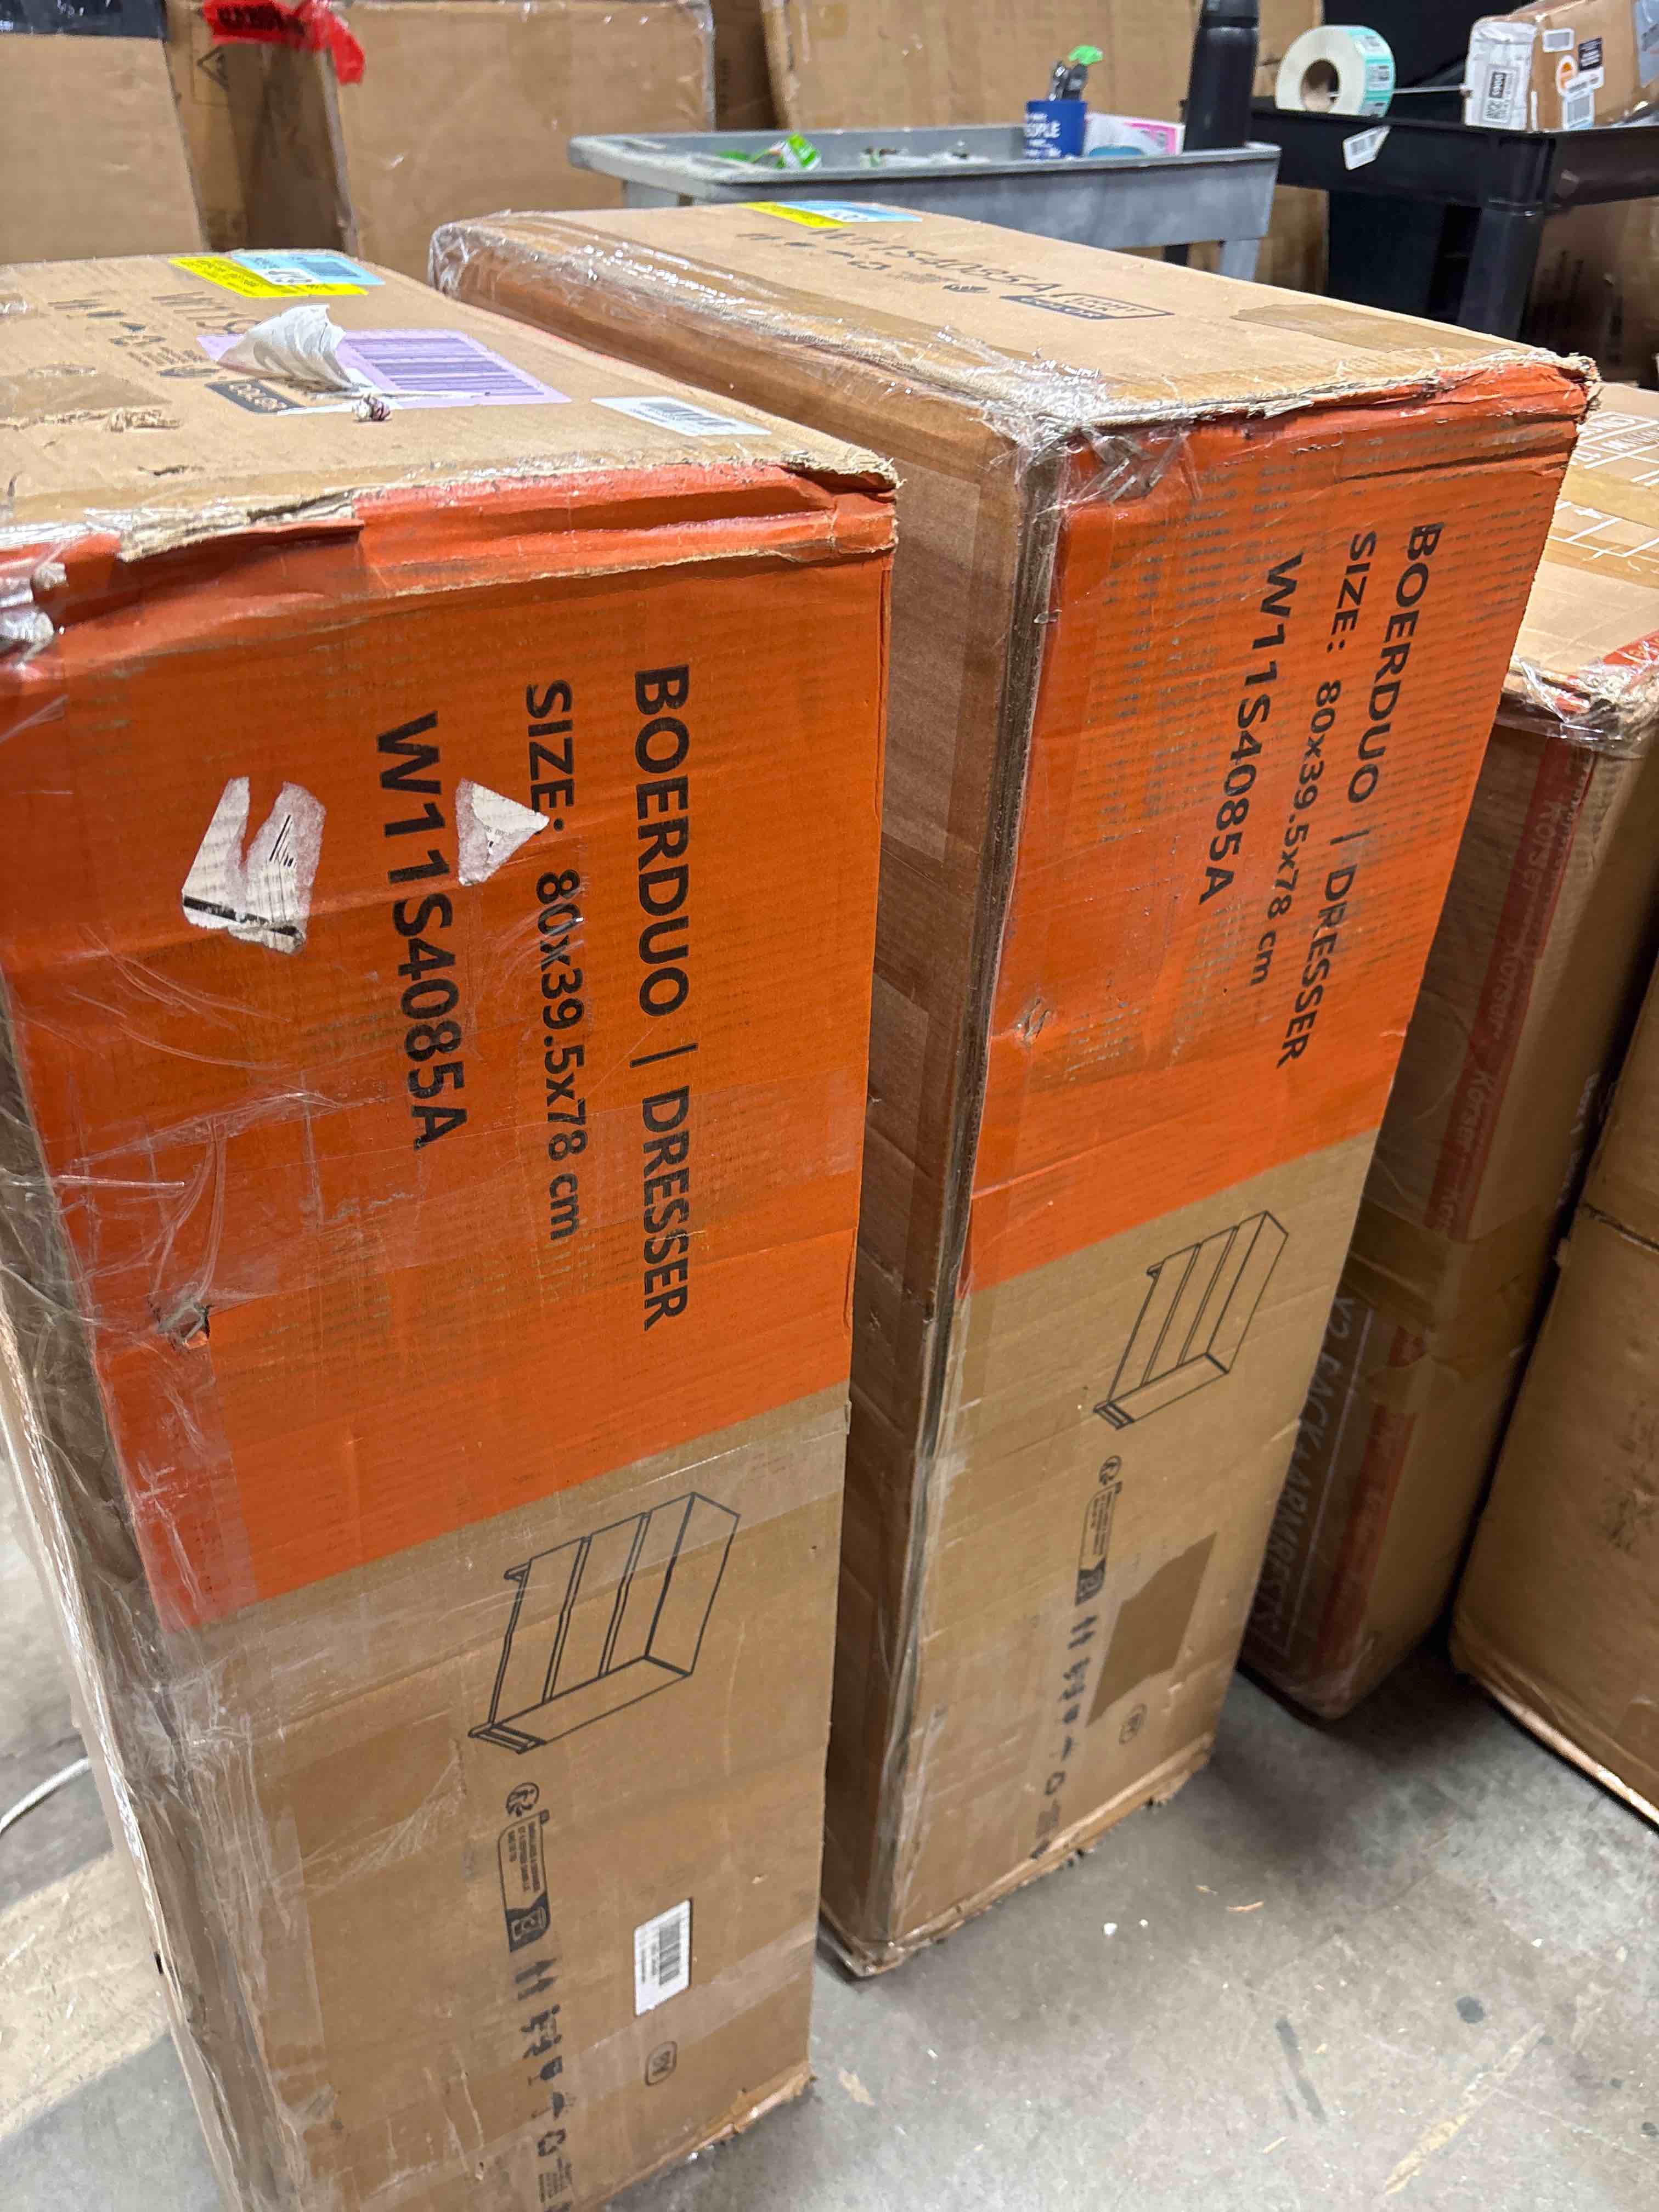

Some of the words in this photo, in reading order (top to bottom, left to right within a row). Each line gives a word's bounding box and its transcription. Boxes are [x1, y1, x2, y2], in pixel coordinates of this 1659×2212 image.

[1326, 531, 1378, 654] SIZE:
[1347, 522, 1445, 804] BOERDUO
[526, 679, 575, 834] SIZE:
[634, 664, 690, 1017] BOERDUO
[1198, 552, 1304, 905] W11S4085A
[1267, 679, 1342, 919] 80x39.5x78
[376, 710, 468, 1151] W11S4085A
[535, 868, 588, 1161] 80x39.5x78
[1250, 930, 1277, 987] cm
[1276, 864, 1357, 1069] DRESSER
[549, 1173, 580, 1240] cm
[641, 1085, 690, 1331] DRESSER
